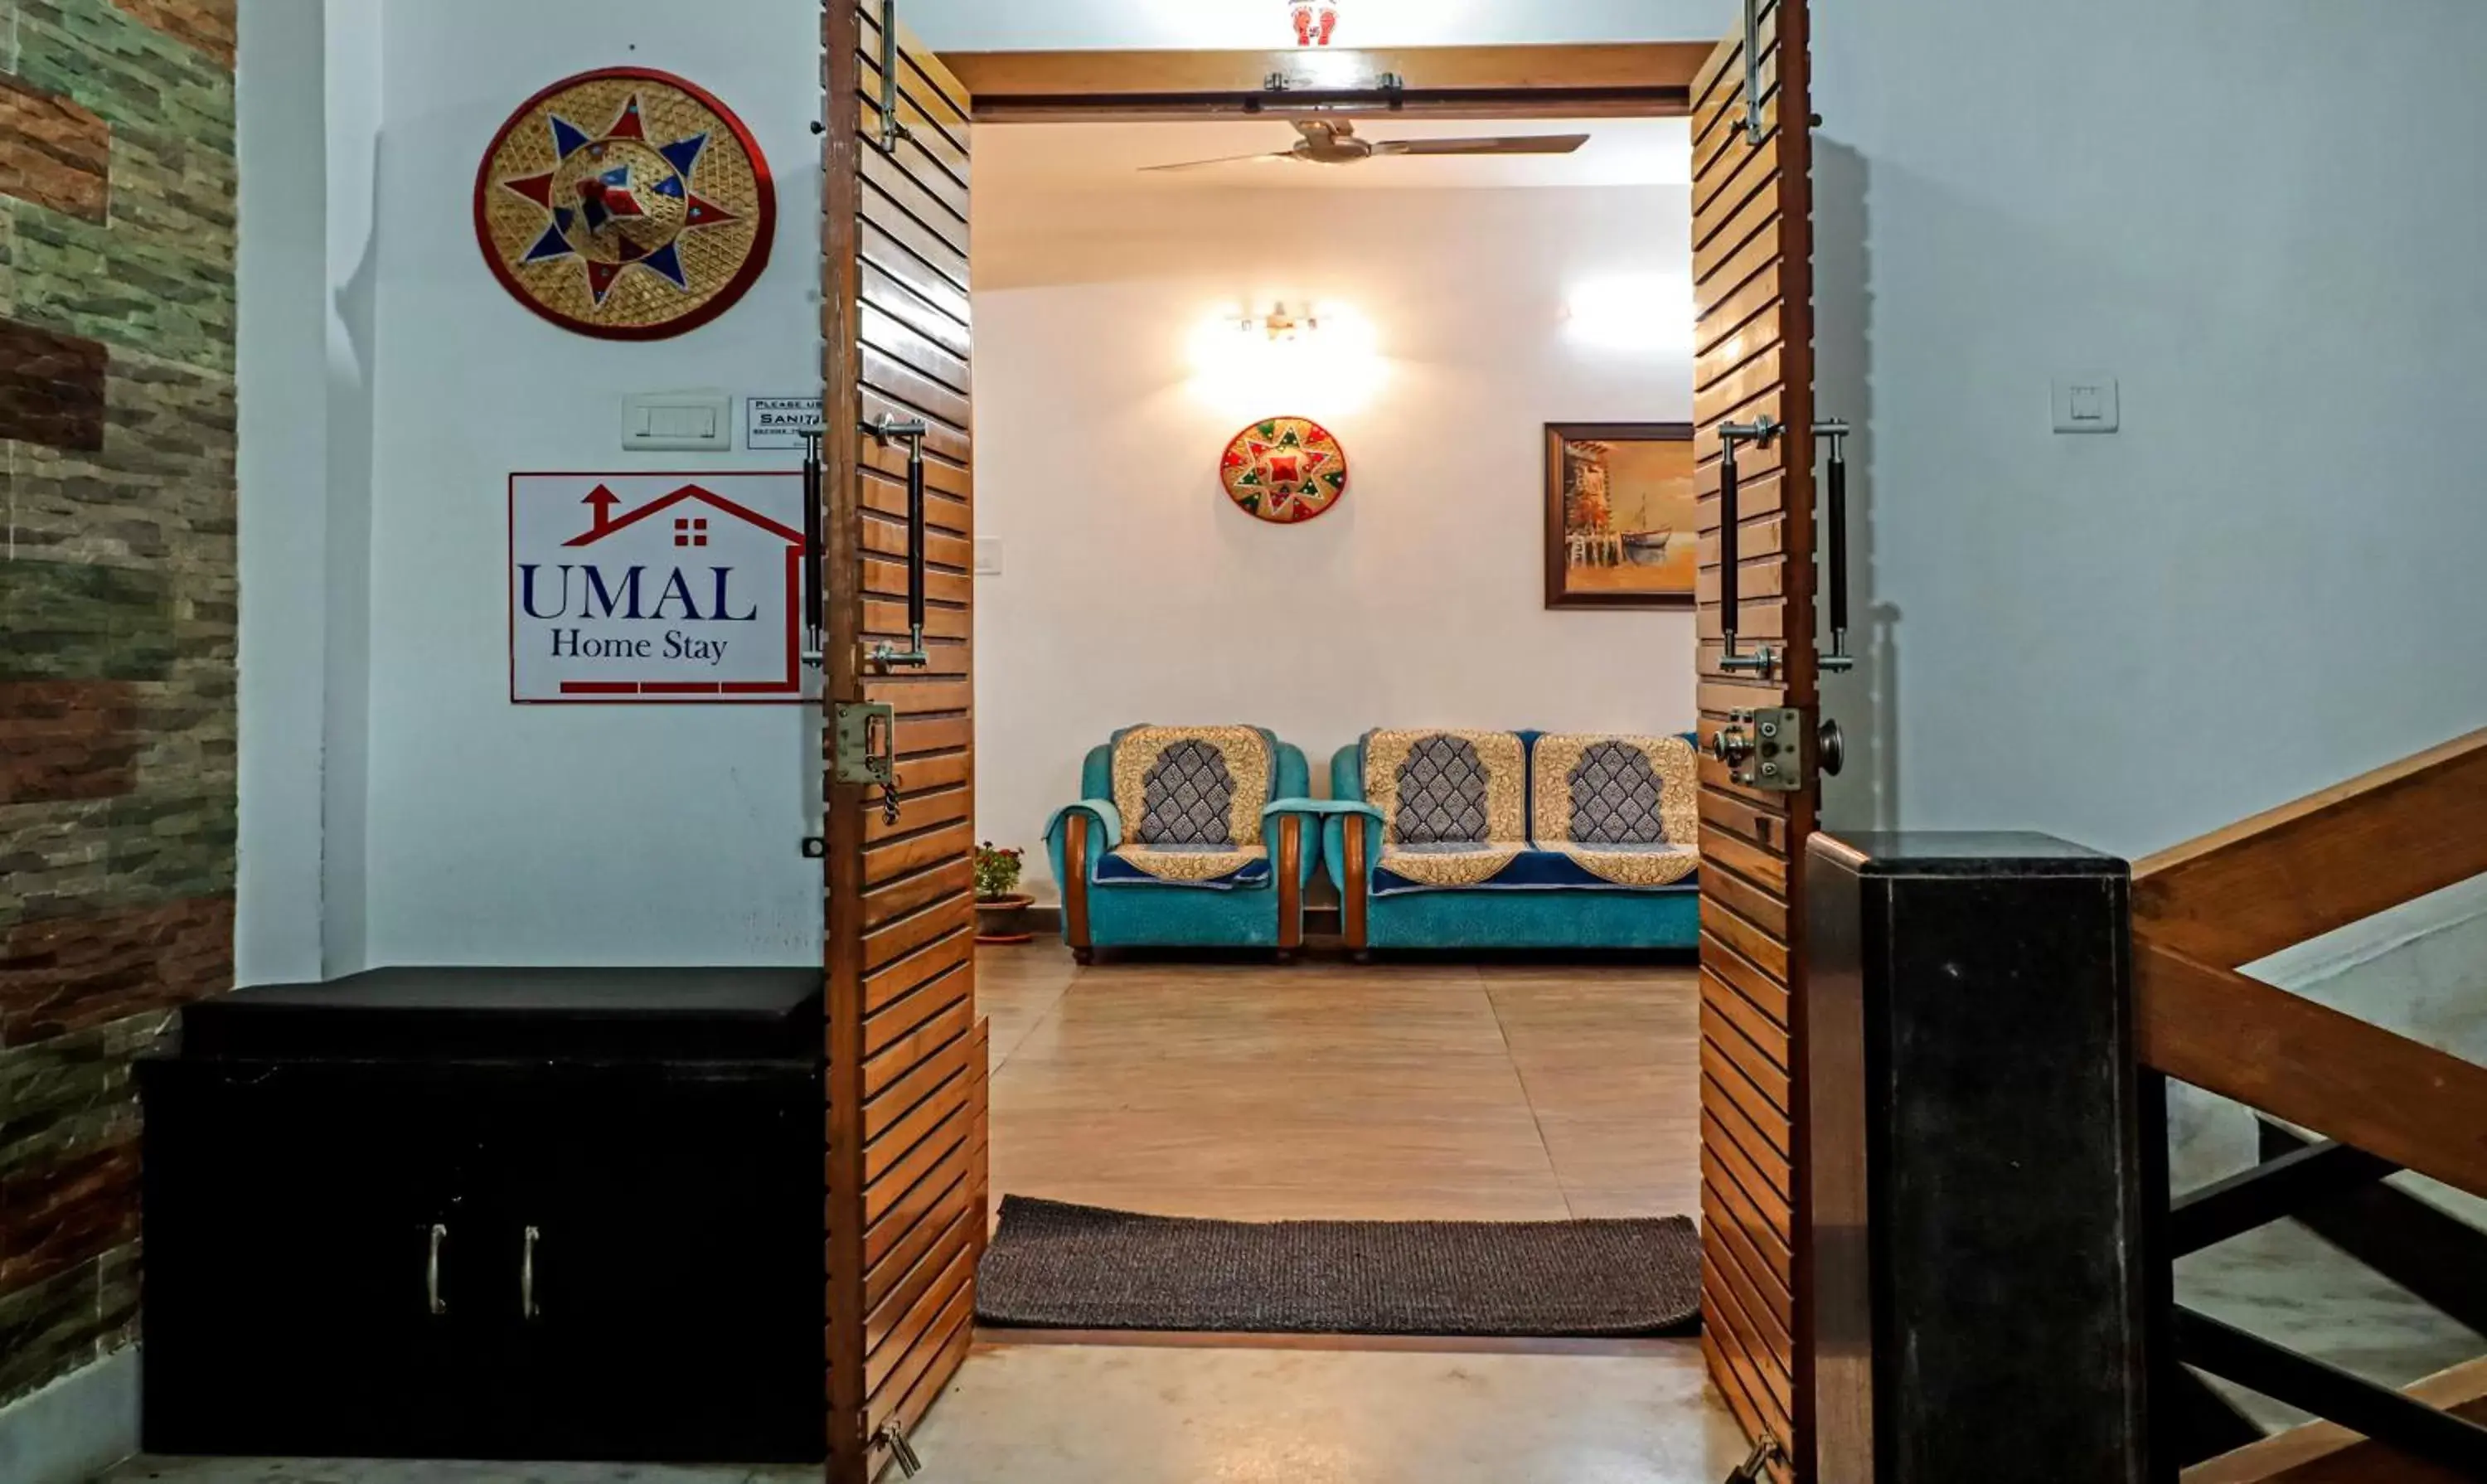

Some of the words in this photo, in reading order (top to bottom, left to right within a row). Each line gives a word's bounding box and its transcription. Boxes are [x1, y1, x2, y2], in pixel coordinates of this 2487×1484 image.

[755, 400, 802, 409] PLEASE
[517, 564, 758, 621] UMAL
[550, 628, 652, 658] Home
[662, 630, 728, 666] Stay
